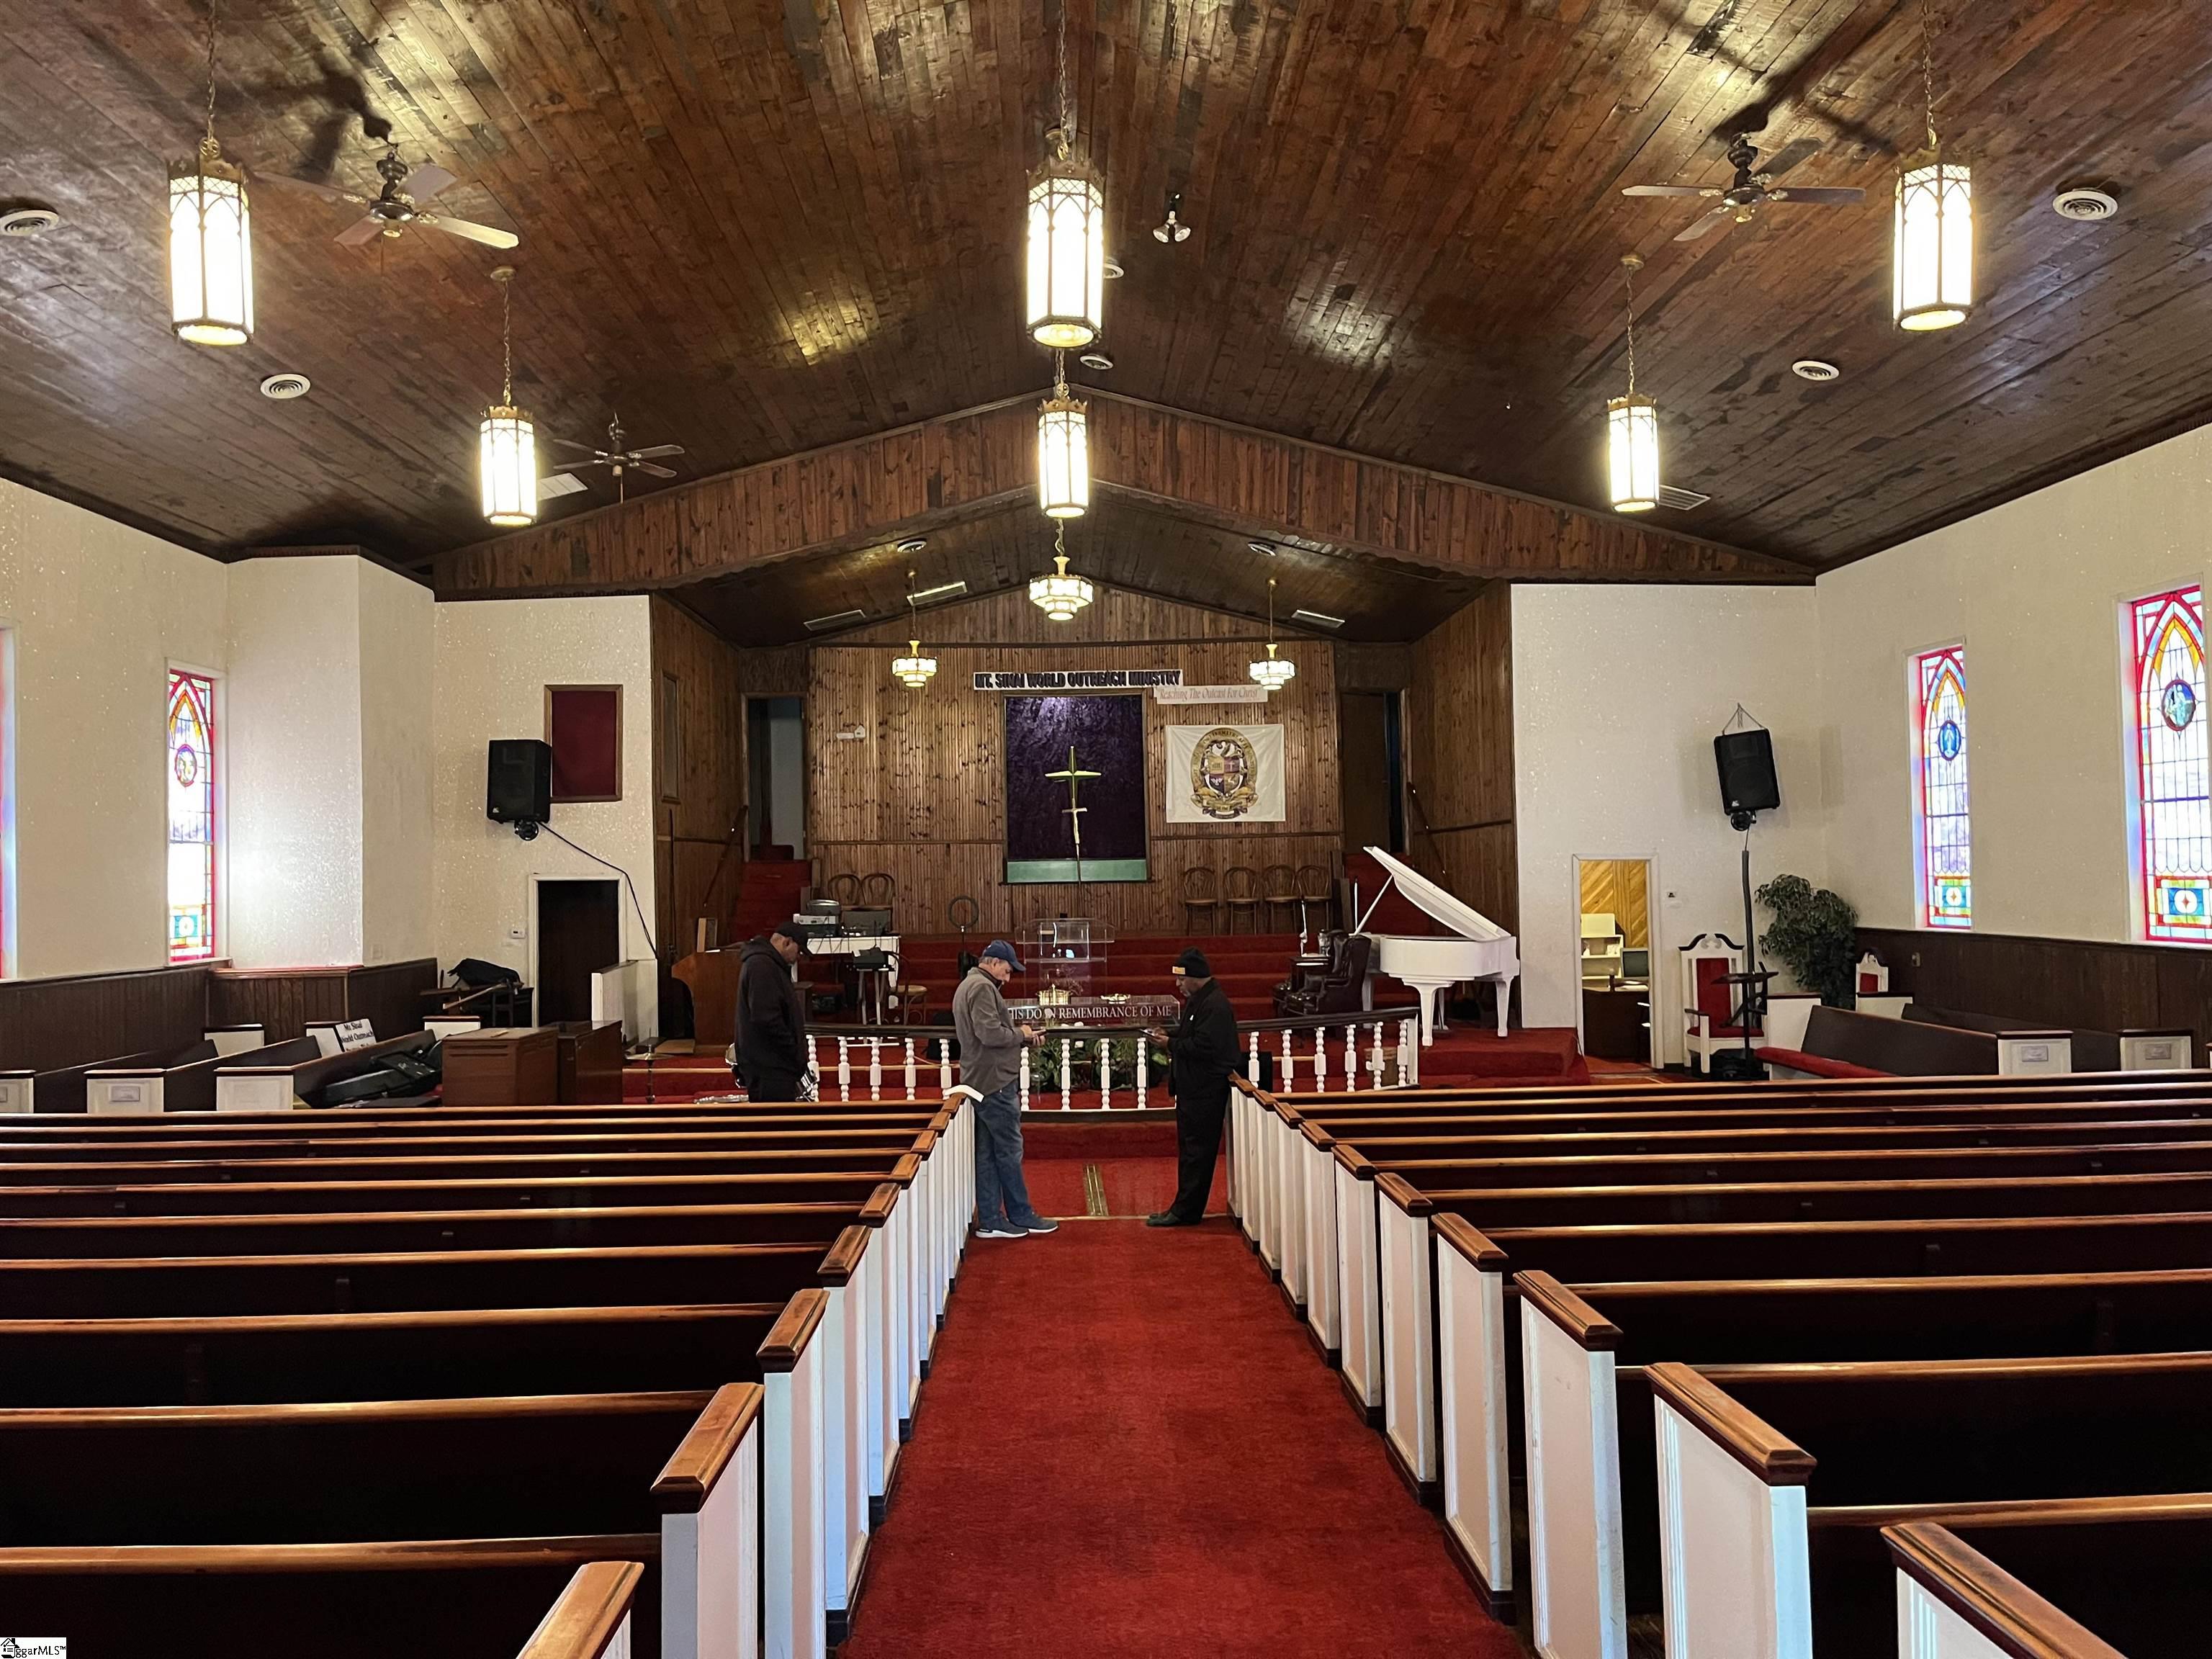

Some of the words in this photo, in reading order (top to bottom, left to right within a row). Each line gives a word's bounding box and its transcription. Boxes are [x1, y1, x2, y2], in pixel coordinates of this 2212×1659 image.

[995, 673, 1025, 688] SINAI
[1027, 673, 1066, 688] WORLD
[1067, 671, 1127, 687] OUTREACH
[1128, 670, 1181, 685] MINISTRY
[1189, 688, 1201, 698] The
[1227, 687, 1238, 698] For
[1026, 1008, 1042, 1020] DO
[1059, 1007, 1138, 1019] REMEMBRANCE
[1140, 1006, 1154, 1017] OF
[1156, 1005, 1172, 1017] ME
